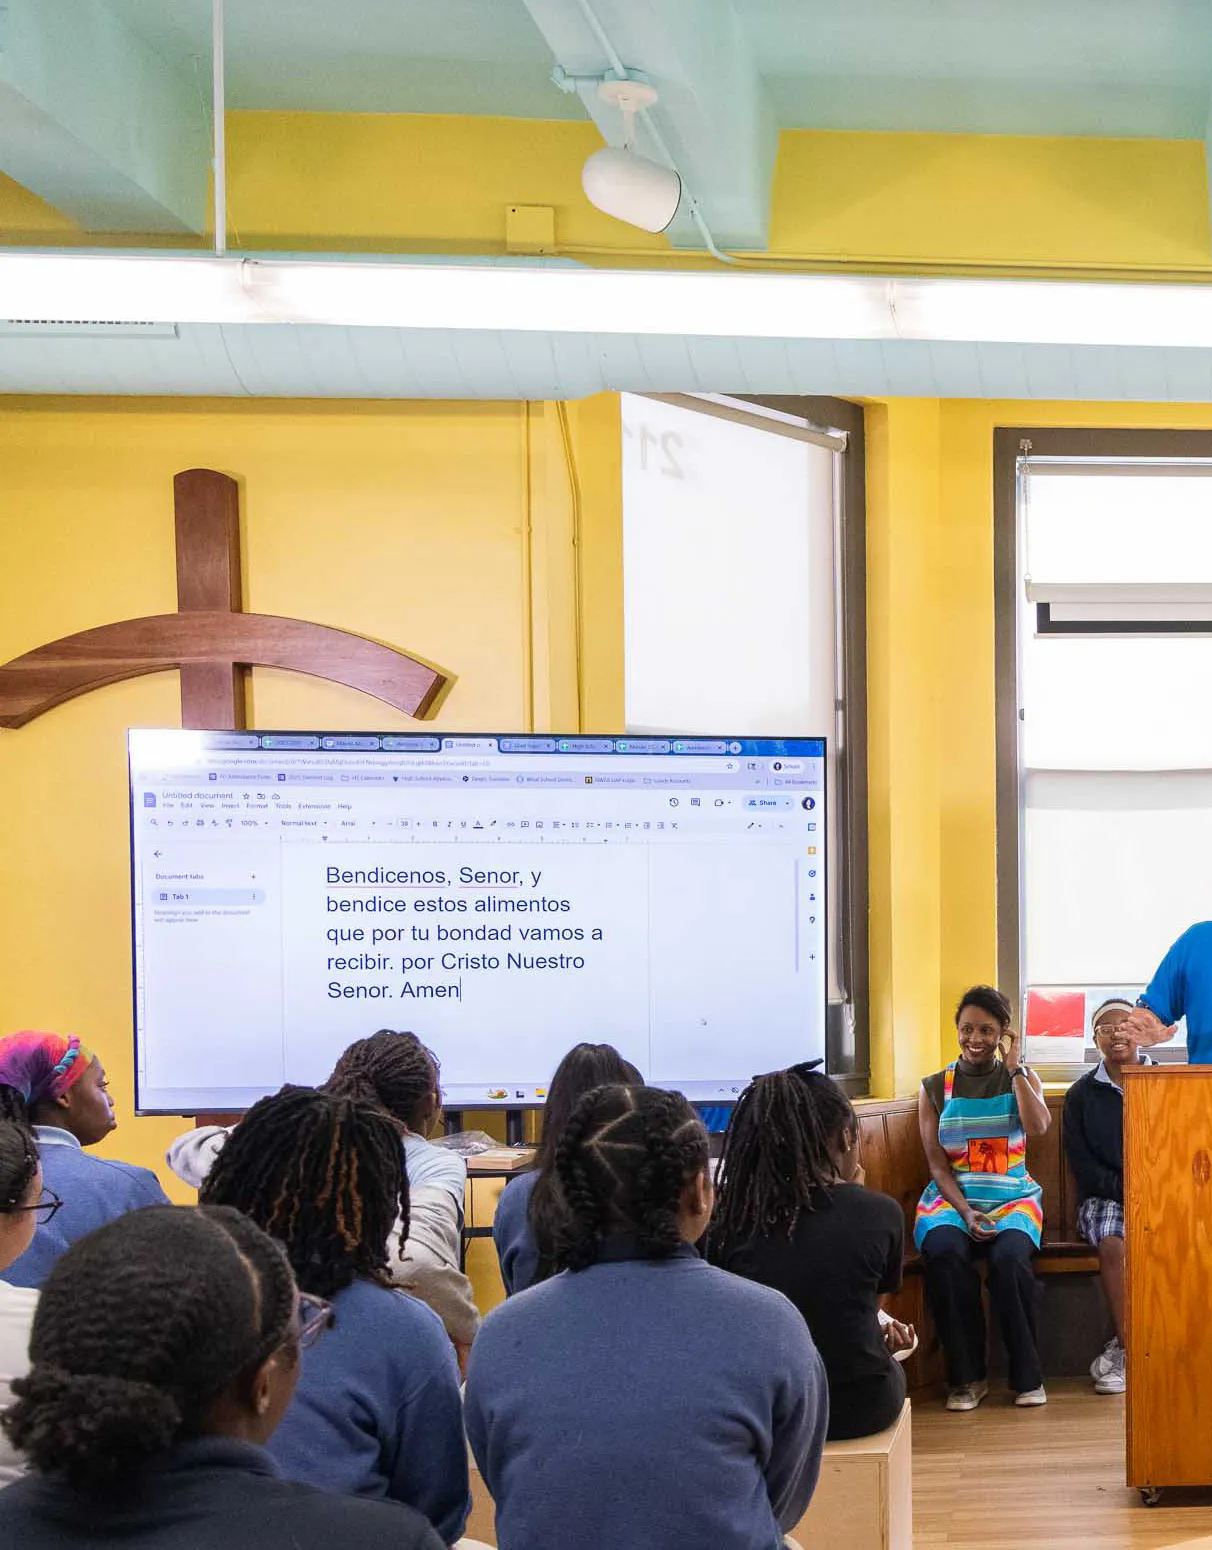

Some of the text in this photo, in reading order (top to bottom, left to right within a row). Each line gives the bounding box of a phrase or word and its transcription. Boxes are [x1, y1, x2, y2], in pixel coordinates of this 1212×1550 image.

[326, 867, 542, 887] Bendicenos, Senor, y
[327, 896, 570, 912] bendice estos alimentos
[326, 924, 603, 945] que por tu bondad vamos a
[327, 953, 585, 974] recibir. por Cristo Nuestro
[327, 982, 459, 998] Senor. Amen
